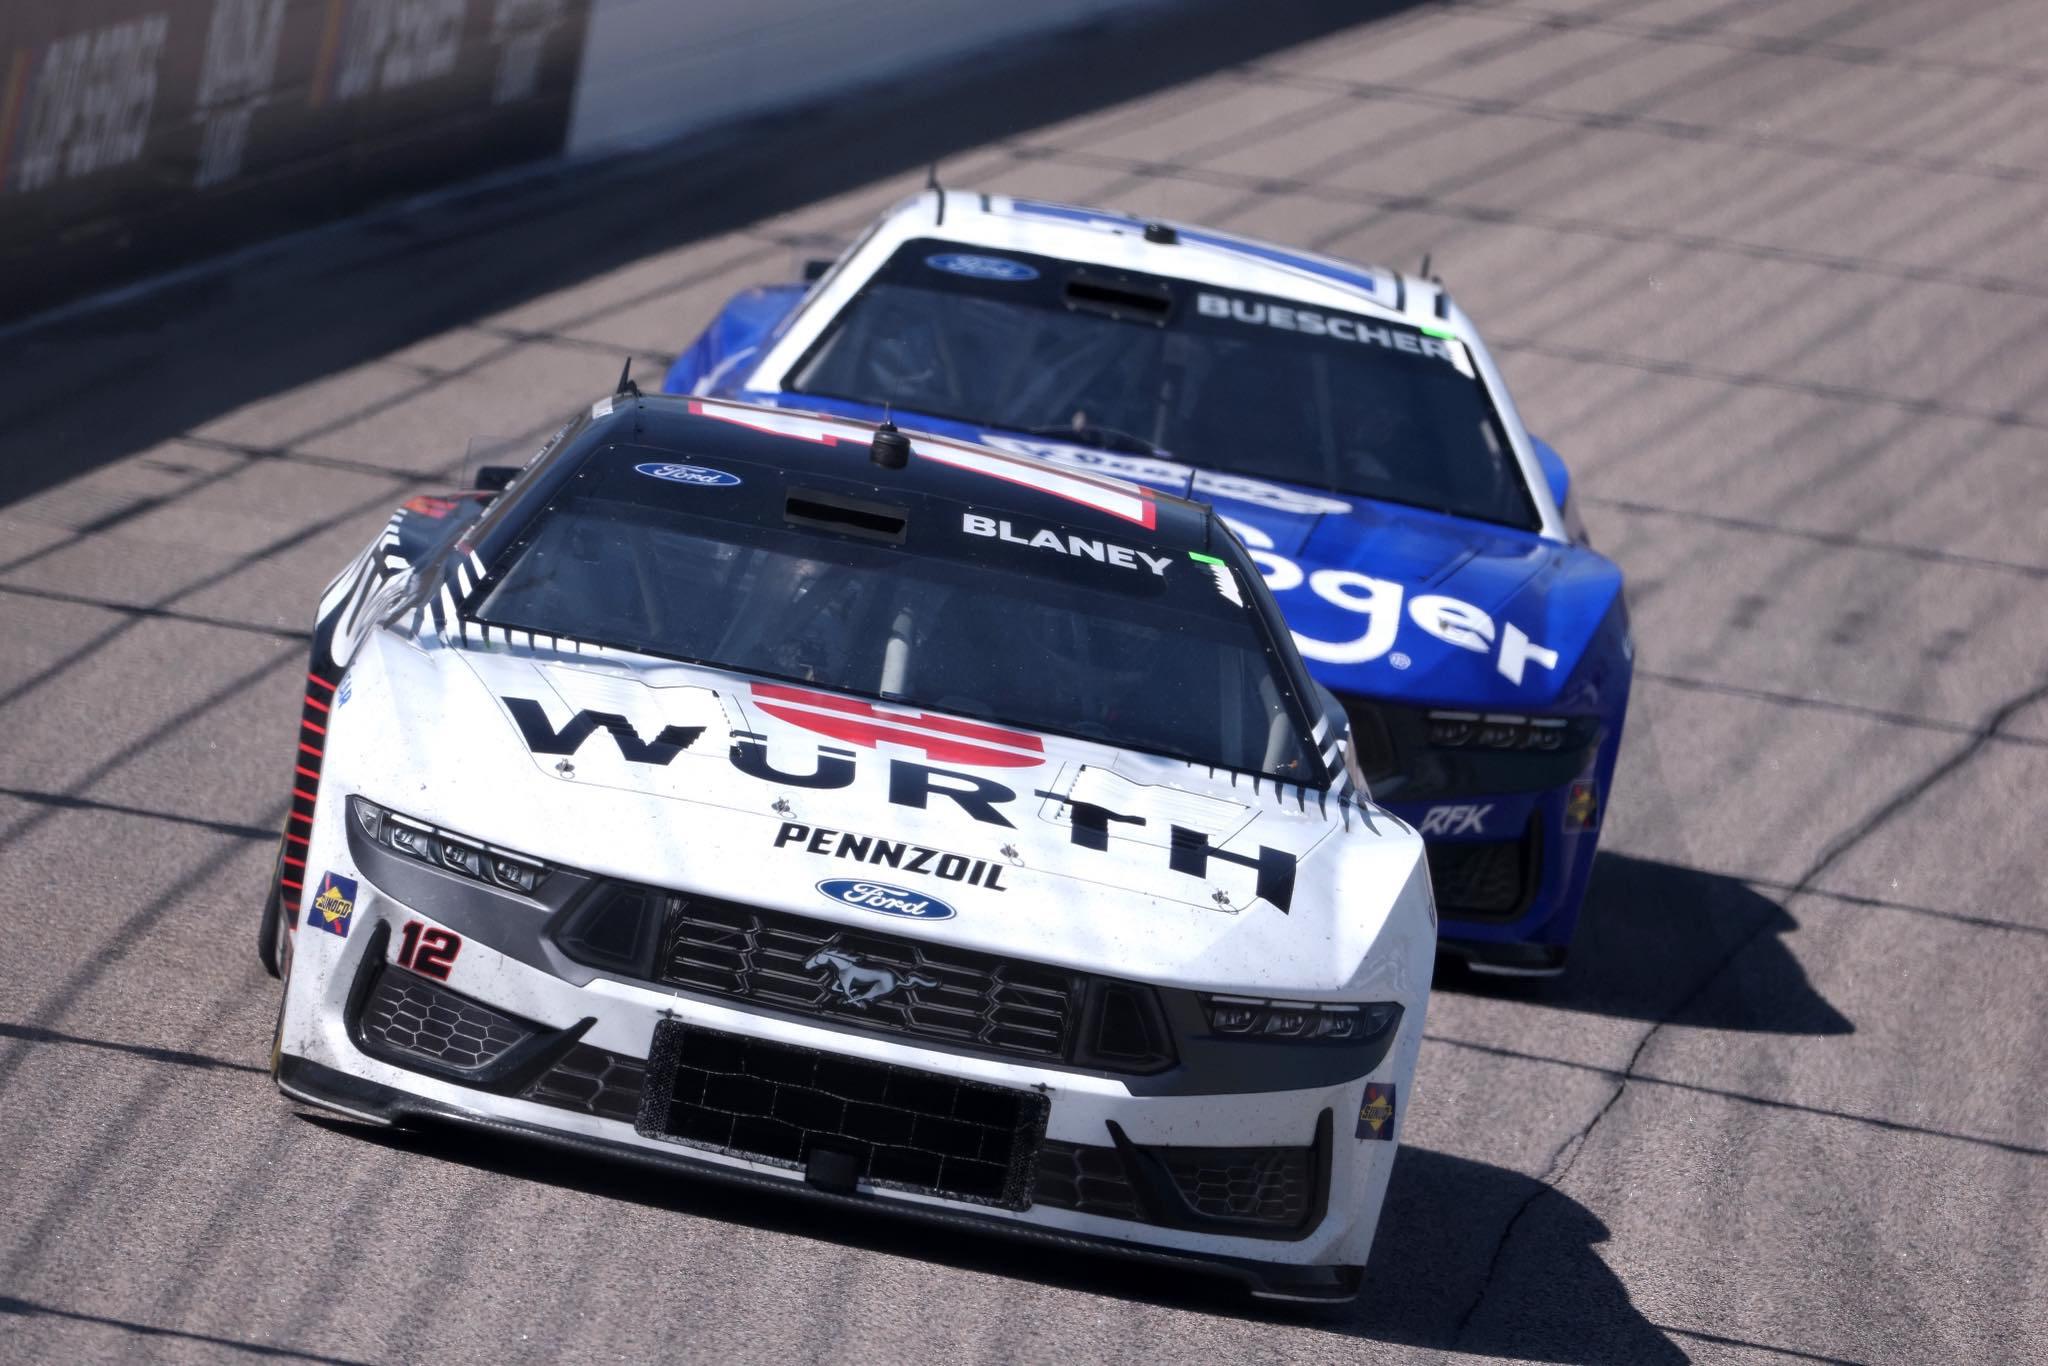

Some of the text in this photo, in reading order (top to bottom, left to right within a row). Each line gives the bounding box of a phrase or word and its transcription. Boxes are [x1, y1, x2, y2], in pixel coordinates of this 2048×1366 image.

[1197, 293, 1455, 361] BUESCHER
[654, 464, 722, 483] Ford
[963, 513, 1173, 576] BLANEY
[1217, 514, 1558, 687] oger
[1420, 804, 1494, 836] RFK
[773, 821, 1008, 892] PENNZOIL
[843, 883, 930, 915] Ford
[396, 919, 463, 982] 12
